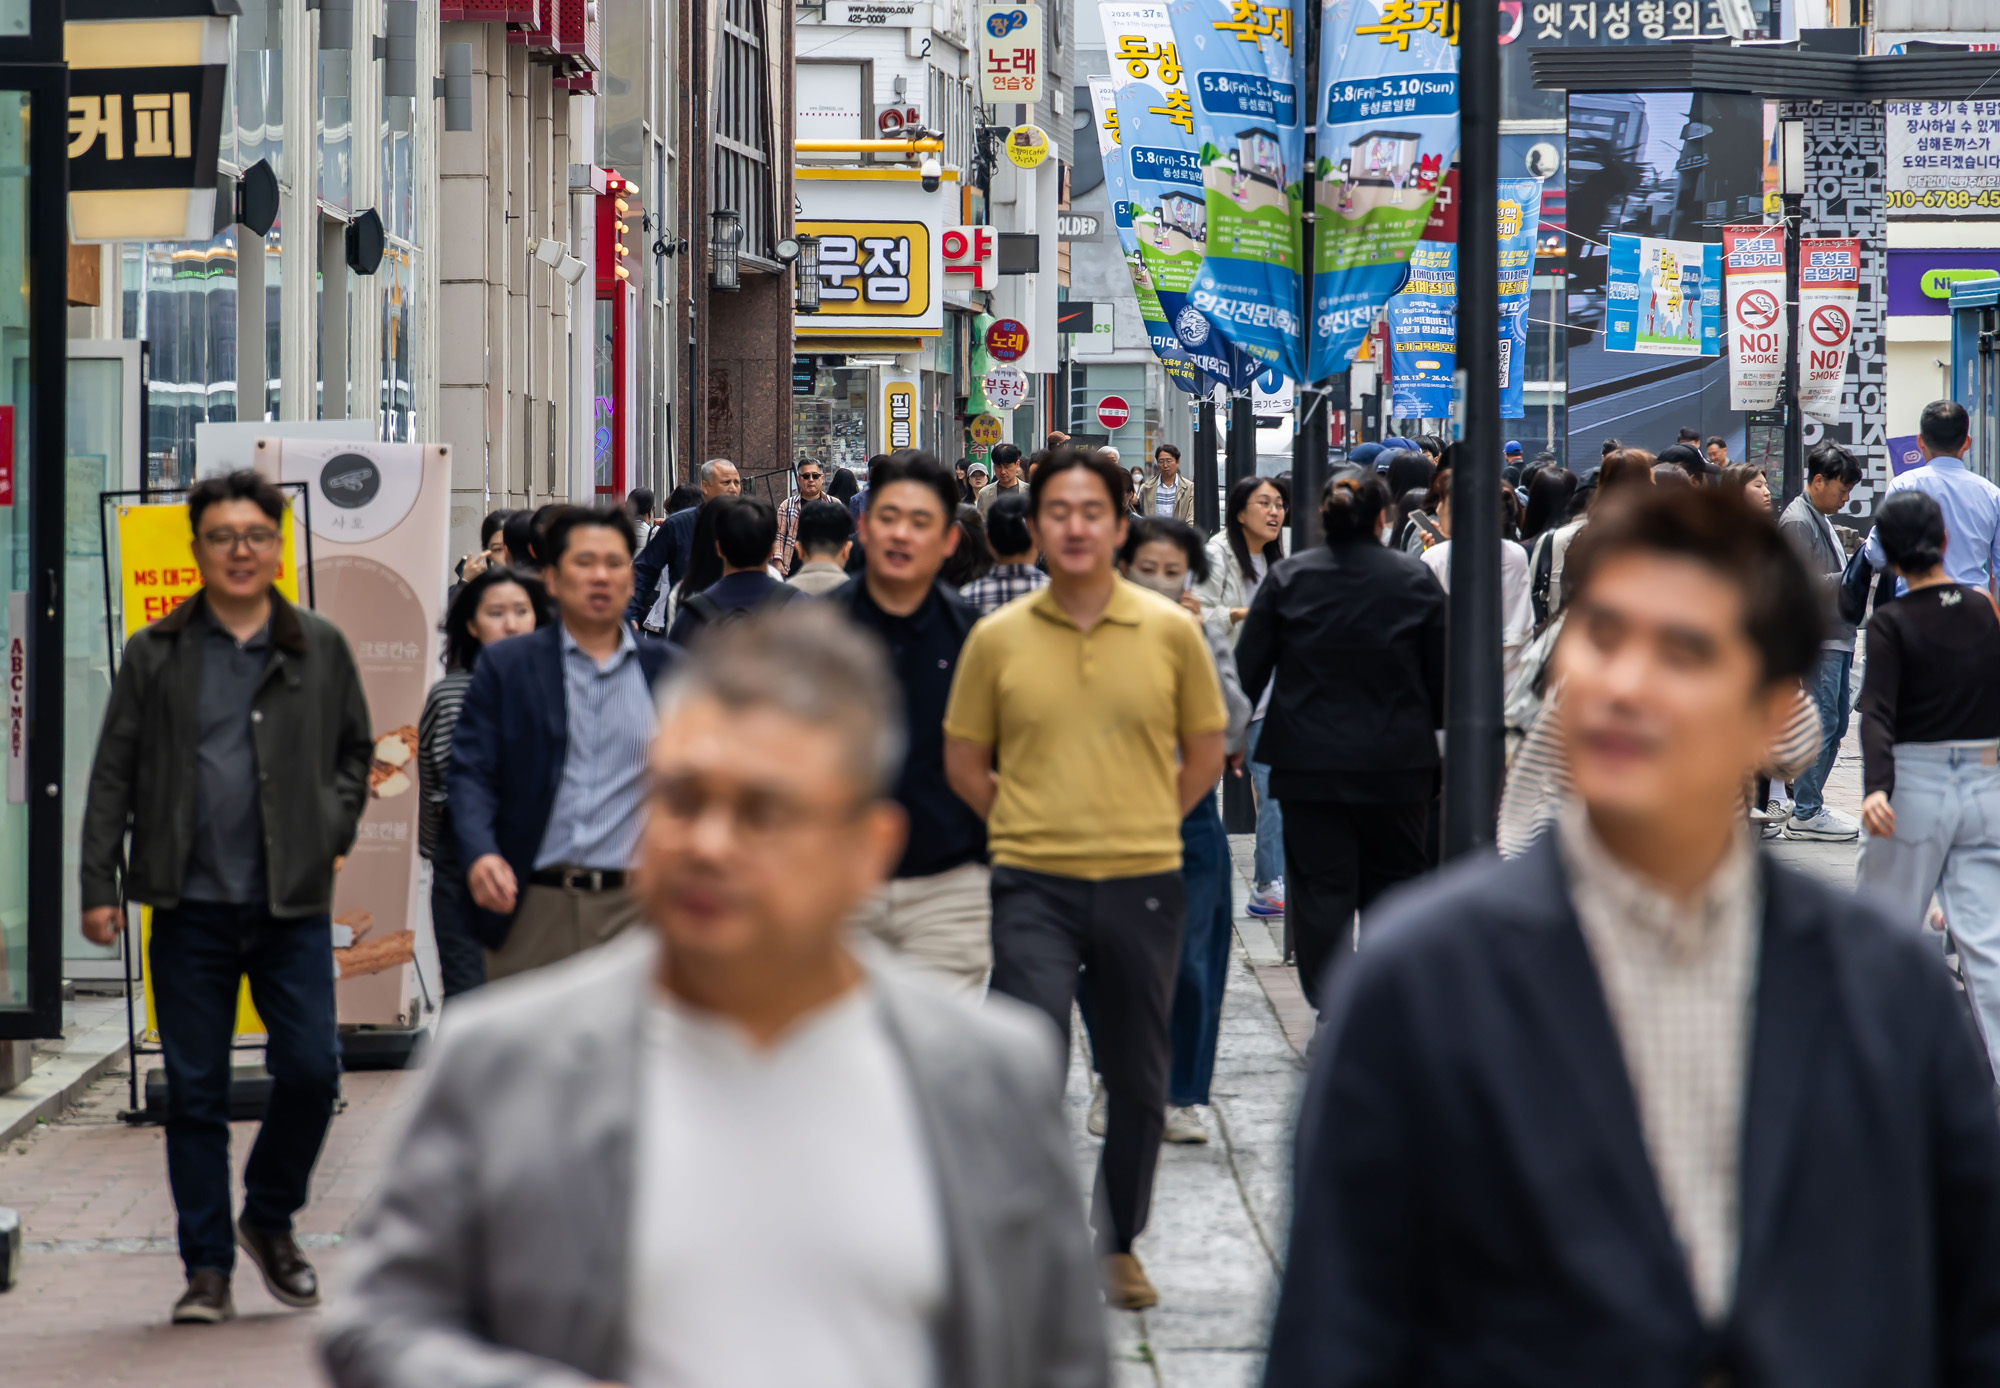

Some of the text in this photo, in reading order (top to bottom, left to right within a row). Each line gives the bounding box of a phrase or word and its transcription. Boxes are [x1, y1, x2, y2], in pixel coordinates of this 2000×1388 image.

[848, 14, 886, 23] 425-0009
[1142, 9, 1155, 18] 37
[1212, 0, 1294, 57] 축제
[921, 38, 931, 59] 2
[987, 48, 1036, 75] 노래
[1115, 35, 1183, 85] 동성
[992, 76, 1035, 91] 연습장
[1360, 97, 1415, 116] 동성로일원
[1888, 102, 1922, 115] 어려운
[1928, 102, 1952, 115] 경기
[1957, 102, 1968, 115] 속
[68, 92, 191, 160] 커피
[1907, 119, 2000, 133] 장사하실 수 있게
[1917, 138, 1990, 151] 심해돈까스가
[1735, 239, 1775, 252] 동성로
[942, 229, 991, 288] 약
[1729, 252, 1782, 267] 금연거리
[1811, 252, 1850, 266] 동성로
[797, 237, 910, 302] 문점
[1804, 267, 1856, 281] 금연거리
[1400, 280, 1456, 296] 용예정자
[1094, 324, 1110, 333] CS
[991, 332, 1024, 351] 노래
[1149, 335, 1183, 350] 미대
[1740, 333, 1778, 353] NO!
[1740, 354, 1778, 364] SMOKE
[1811, 350, 1845, 369] NO!
[1809, 371, 1839, 381] SMOKE
[985, 379, 1025, 397] 부동산
[998, 398, 1010, 408] 3F
[892, 394, 910, 447] 필름
[135, 567, 205, 586] MS 대구
